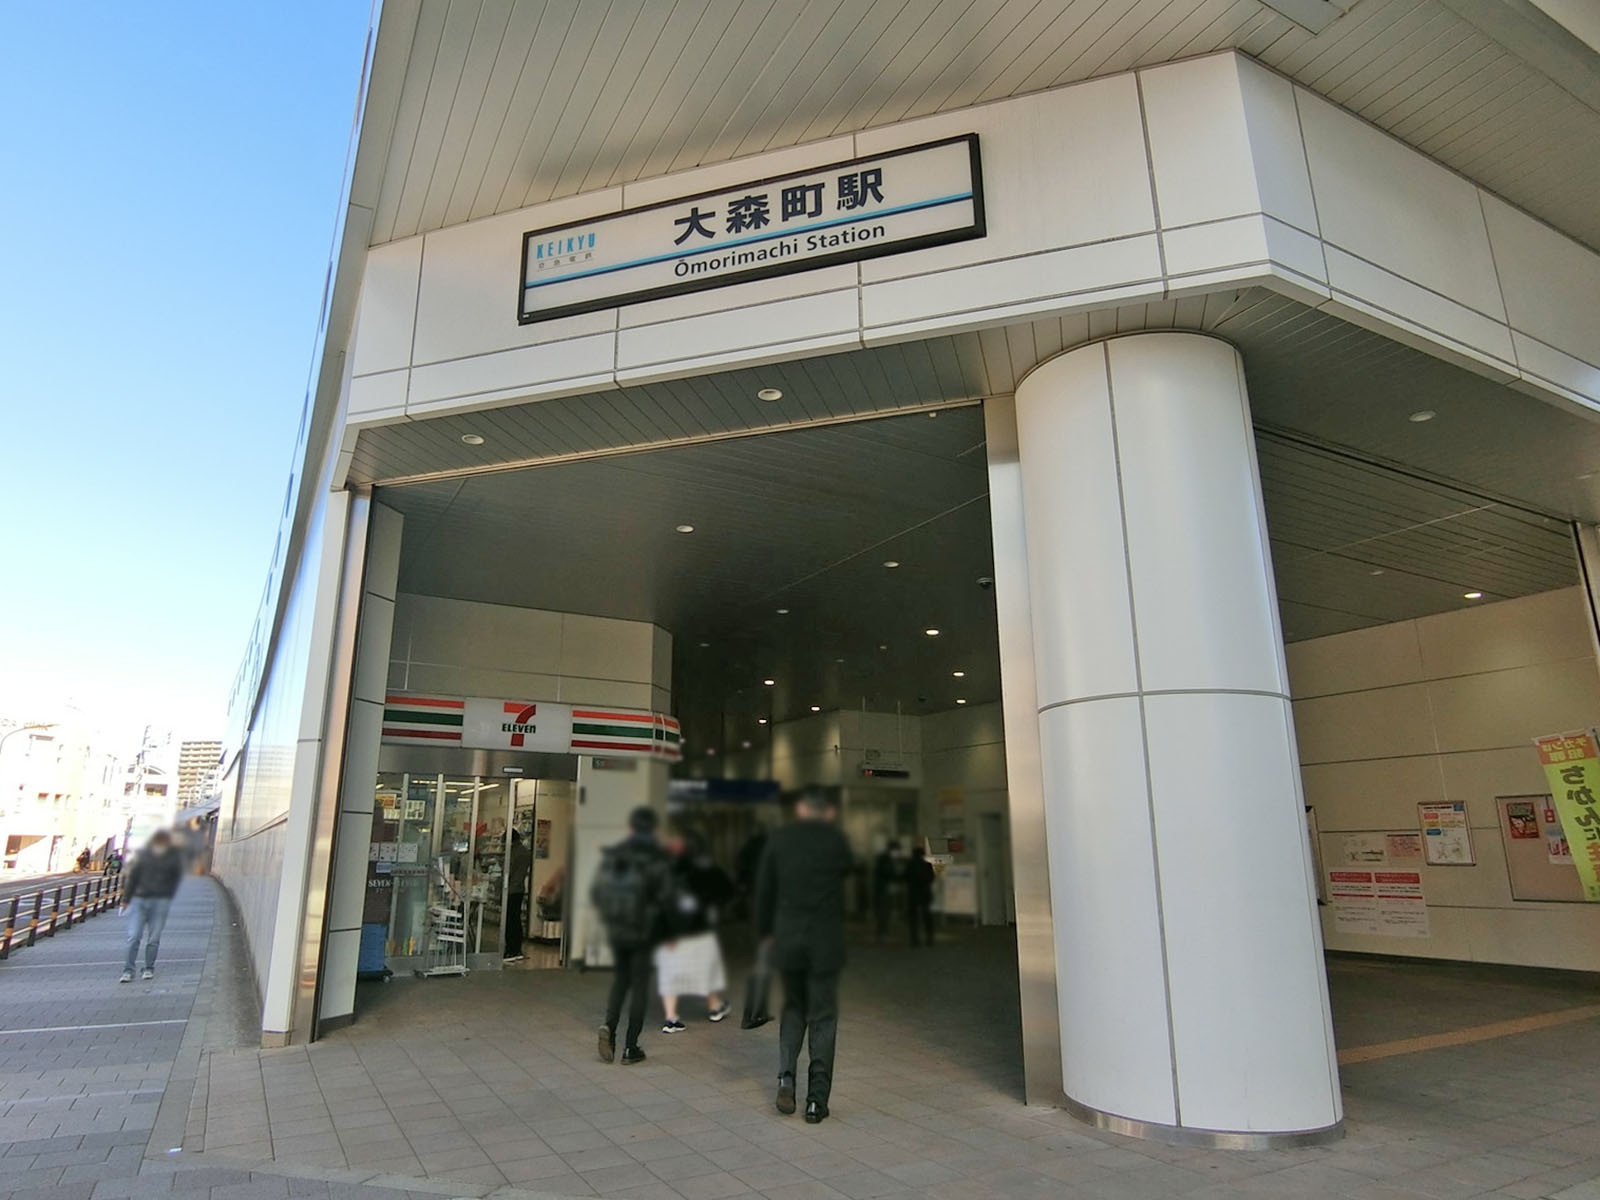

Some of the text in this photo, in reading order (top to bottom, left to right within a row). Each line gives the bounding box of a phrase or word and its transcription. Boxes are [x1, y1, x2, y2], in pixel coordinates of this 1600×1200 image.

[674, 168, 884, 246] 大森町駅
[536, 232, 595, 259] KEIKYU
[674, 225, 885, 277] Ōmorimachi Station
[504, 702, 536, 747] 7
